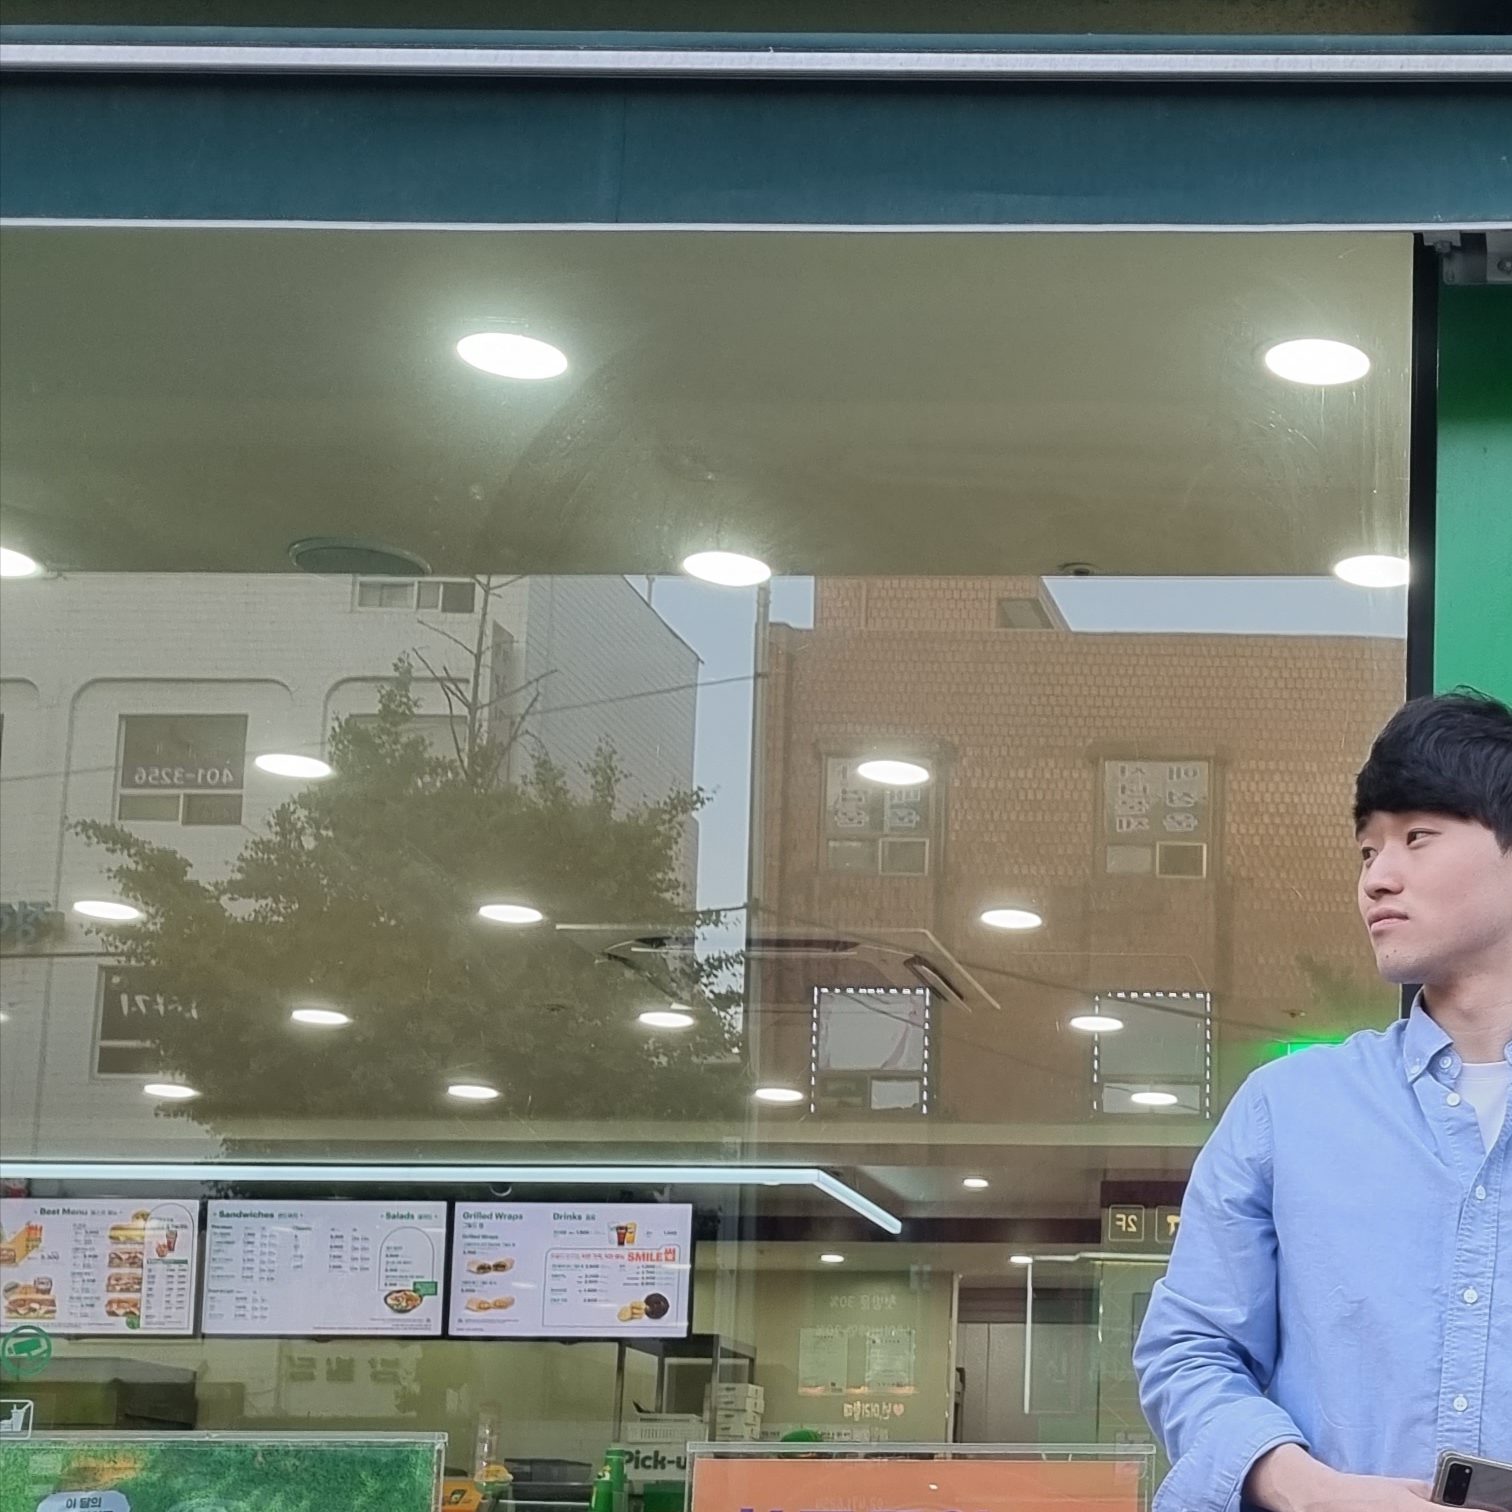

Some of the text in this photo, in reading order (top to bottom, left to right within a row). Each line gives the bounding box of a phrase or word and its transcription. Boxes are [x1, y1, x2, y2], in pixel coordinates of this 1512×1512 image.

[62, 1207, 88, 1216] Menu
[219, 1210, 275, 1219] Sandwiches
[385, 1211, 415, 1220] Salads
[495, 1212, 523, 1221] Wraps
[553, 1212, 582, 1221] Drinks
[624, 1450, 686, 1470] Pick-u
[65, 1497, 101, 1509] 이 달의
